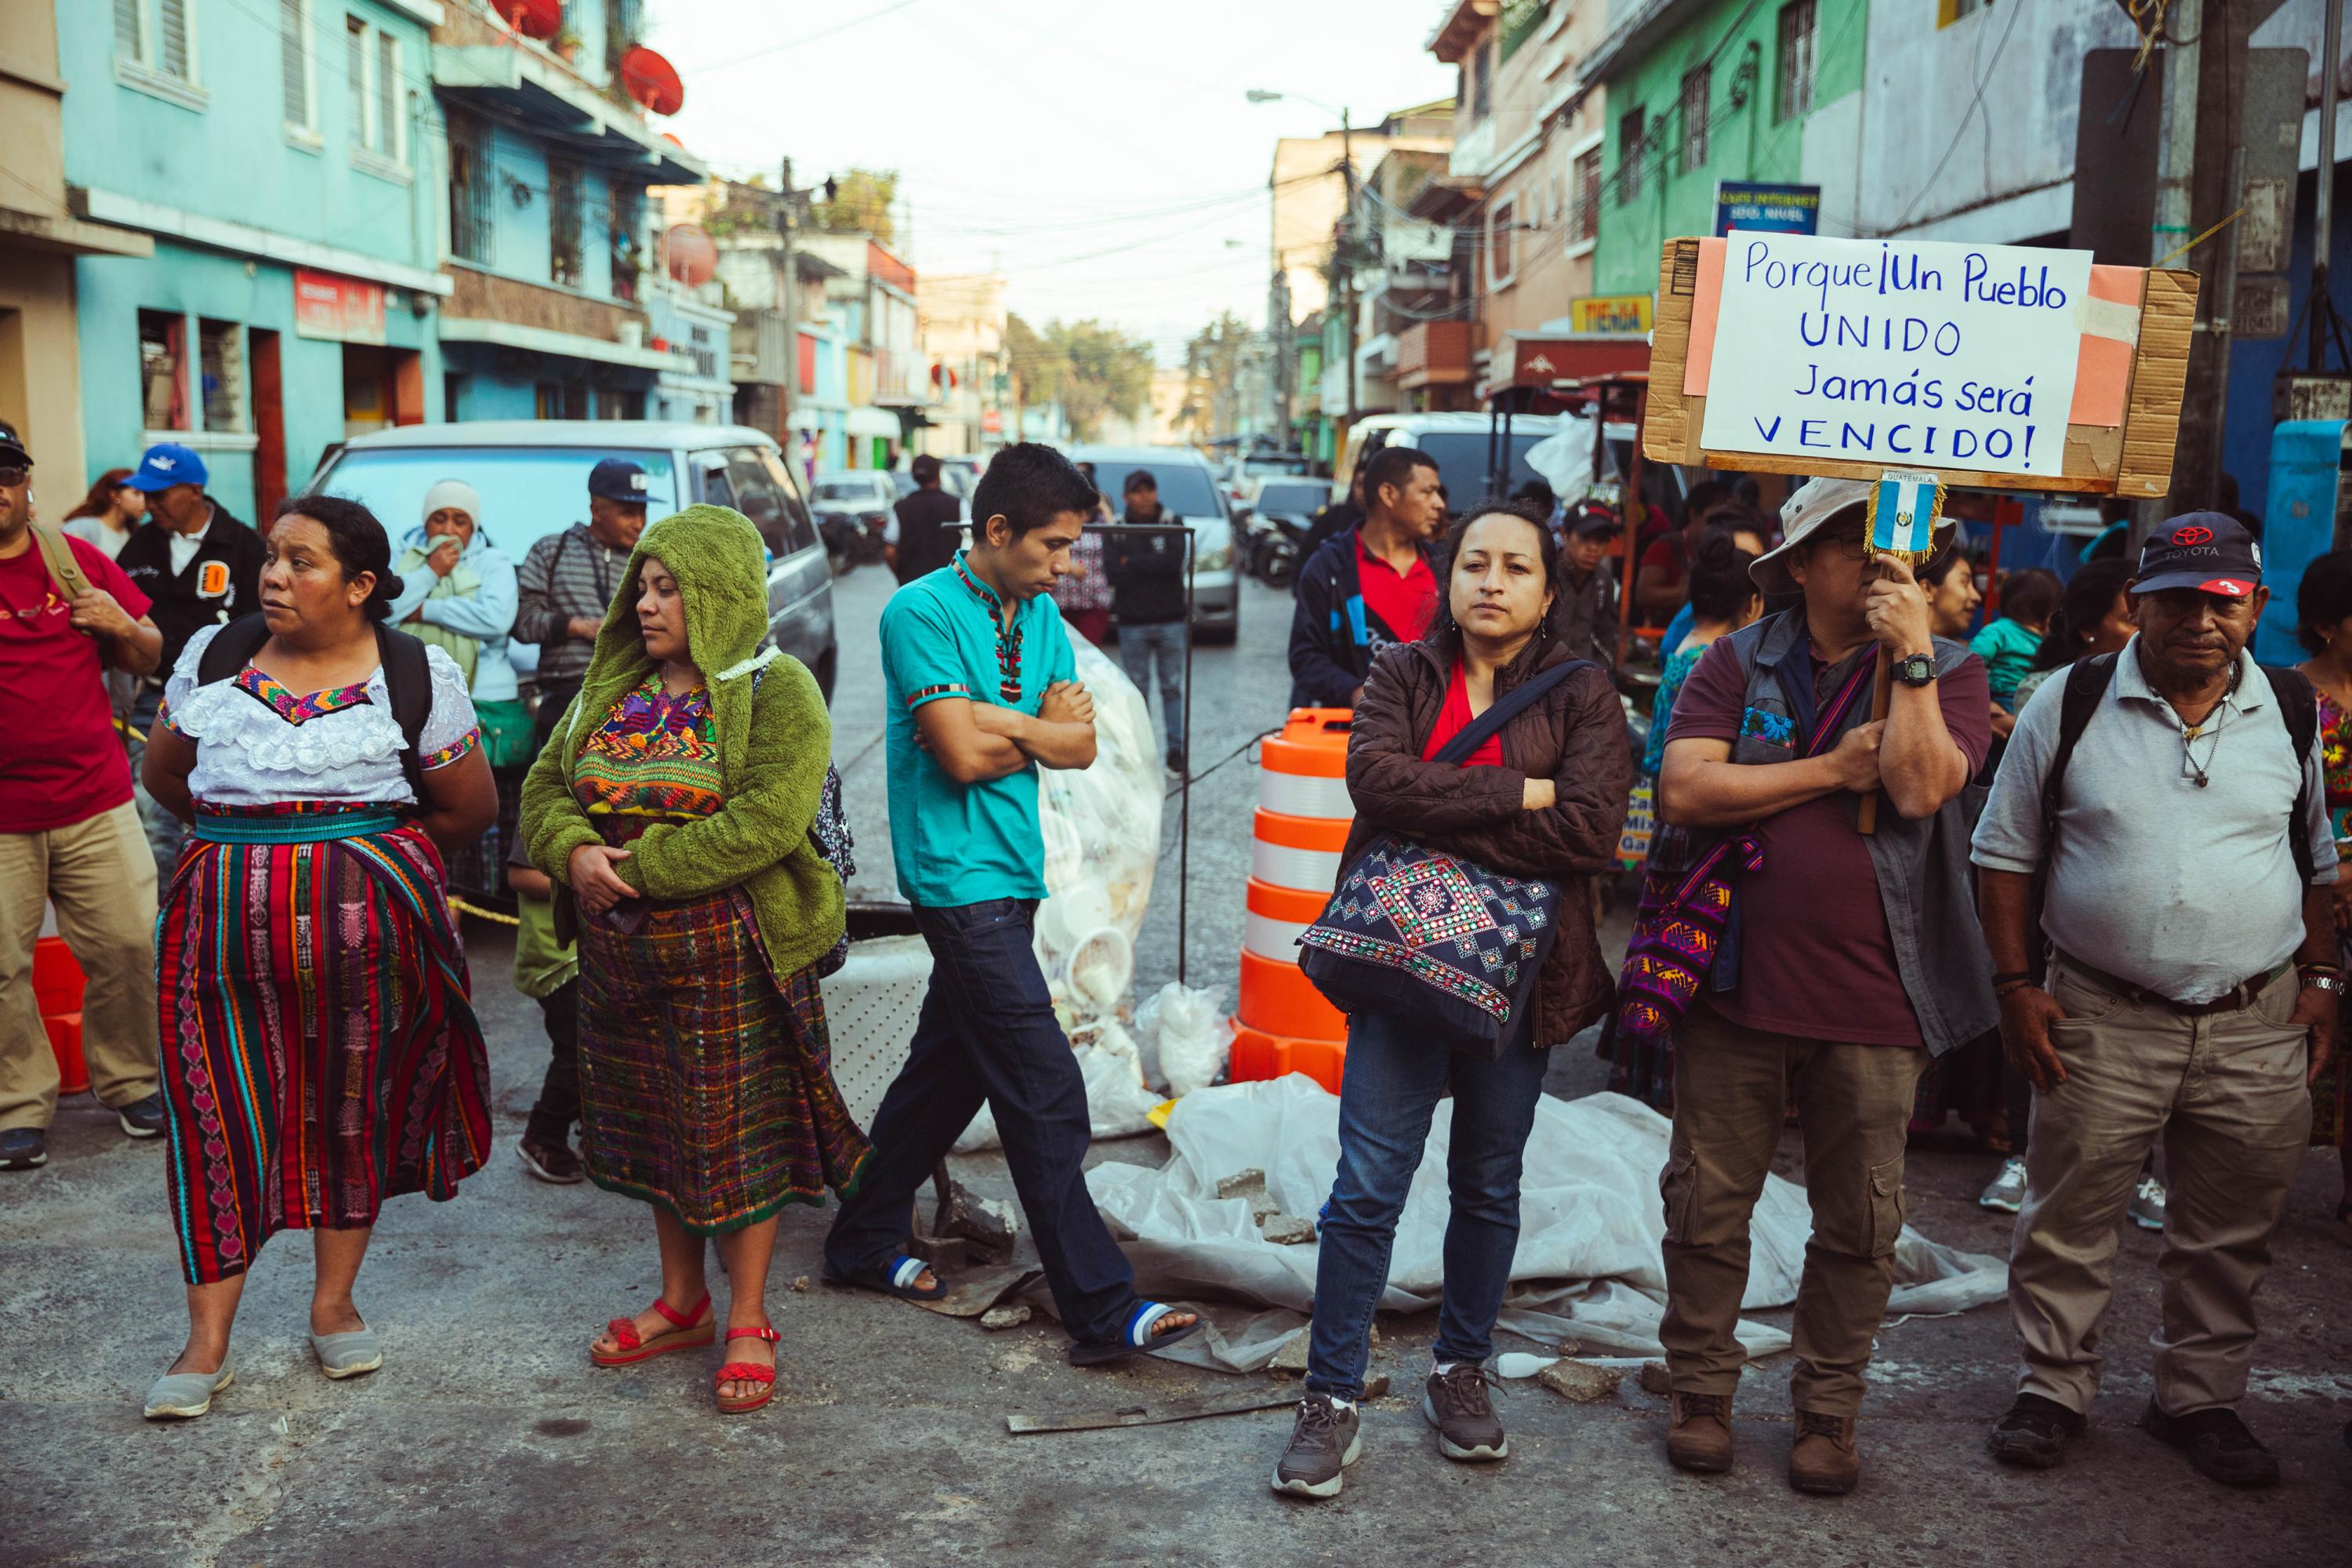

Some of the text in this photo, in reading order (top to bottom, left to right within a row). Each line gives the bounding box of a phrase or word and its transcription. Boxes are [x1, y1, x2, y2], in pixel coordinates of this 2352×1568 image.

[1746, 241, 1872, 312] Porque
[1964, 252, 2067, 310] Pueblo
[1800, 310, 1961, 357] UNIDO
[1794, 364, 2034, 417] Jamás será
[1754, 416, 2036, 469] VENCIDO!
[1888, 474, 1933, 483] GUATEMALA
[2165, 546, 2220, 560] TOYOTA
[719, 659, 753, 681] ASHION
